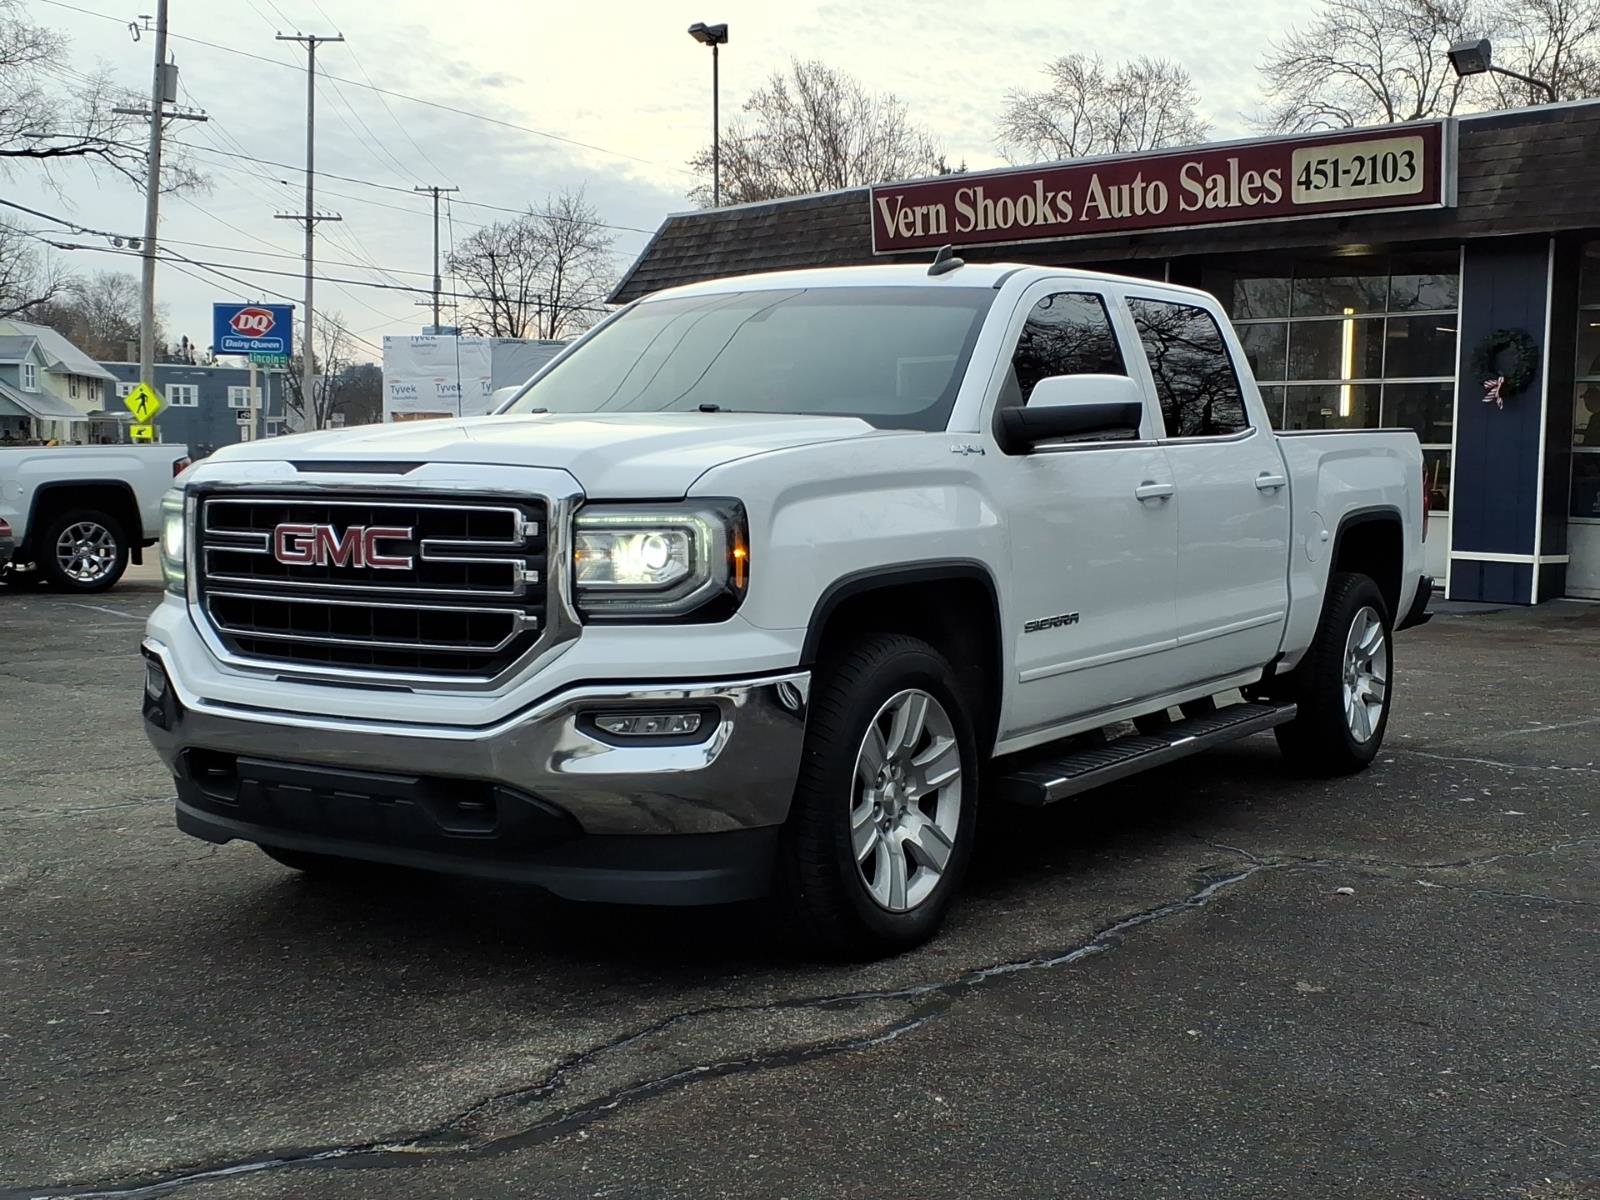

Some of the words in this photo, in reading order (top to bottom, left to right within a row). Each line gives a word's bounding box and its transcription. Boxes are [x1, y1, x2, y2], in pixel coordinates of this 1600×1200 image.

[877, 194, 948, 239] Vern
[954, 180, 1074, 232] Shooks
[1081, 171, 1169, 220] Auto
[1178, 158, 1283, 212] Sales
[1296, 150, 1418, 191] 451-2103
[238, 314, 269, 332] DQ
[225, 339, 249, 349] Dairy
[250, 340, 280, 349] Queen
[249, 353, 279, 364] Lincoln
[390, 385, 417, 395] Tyvek
[274, 523, 413, 570] GMC
[1024, 612, 1080, 634] SIERRA
